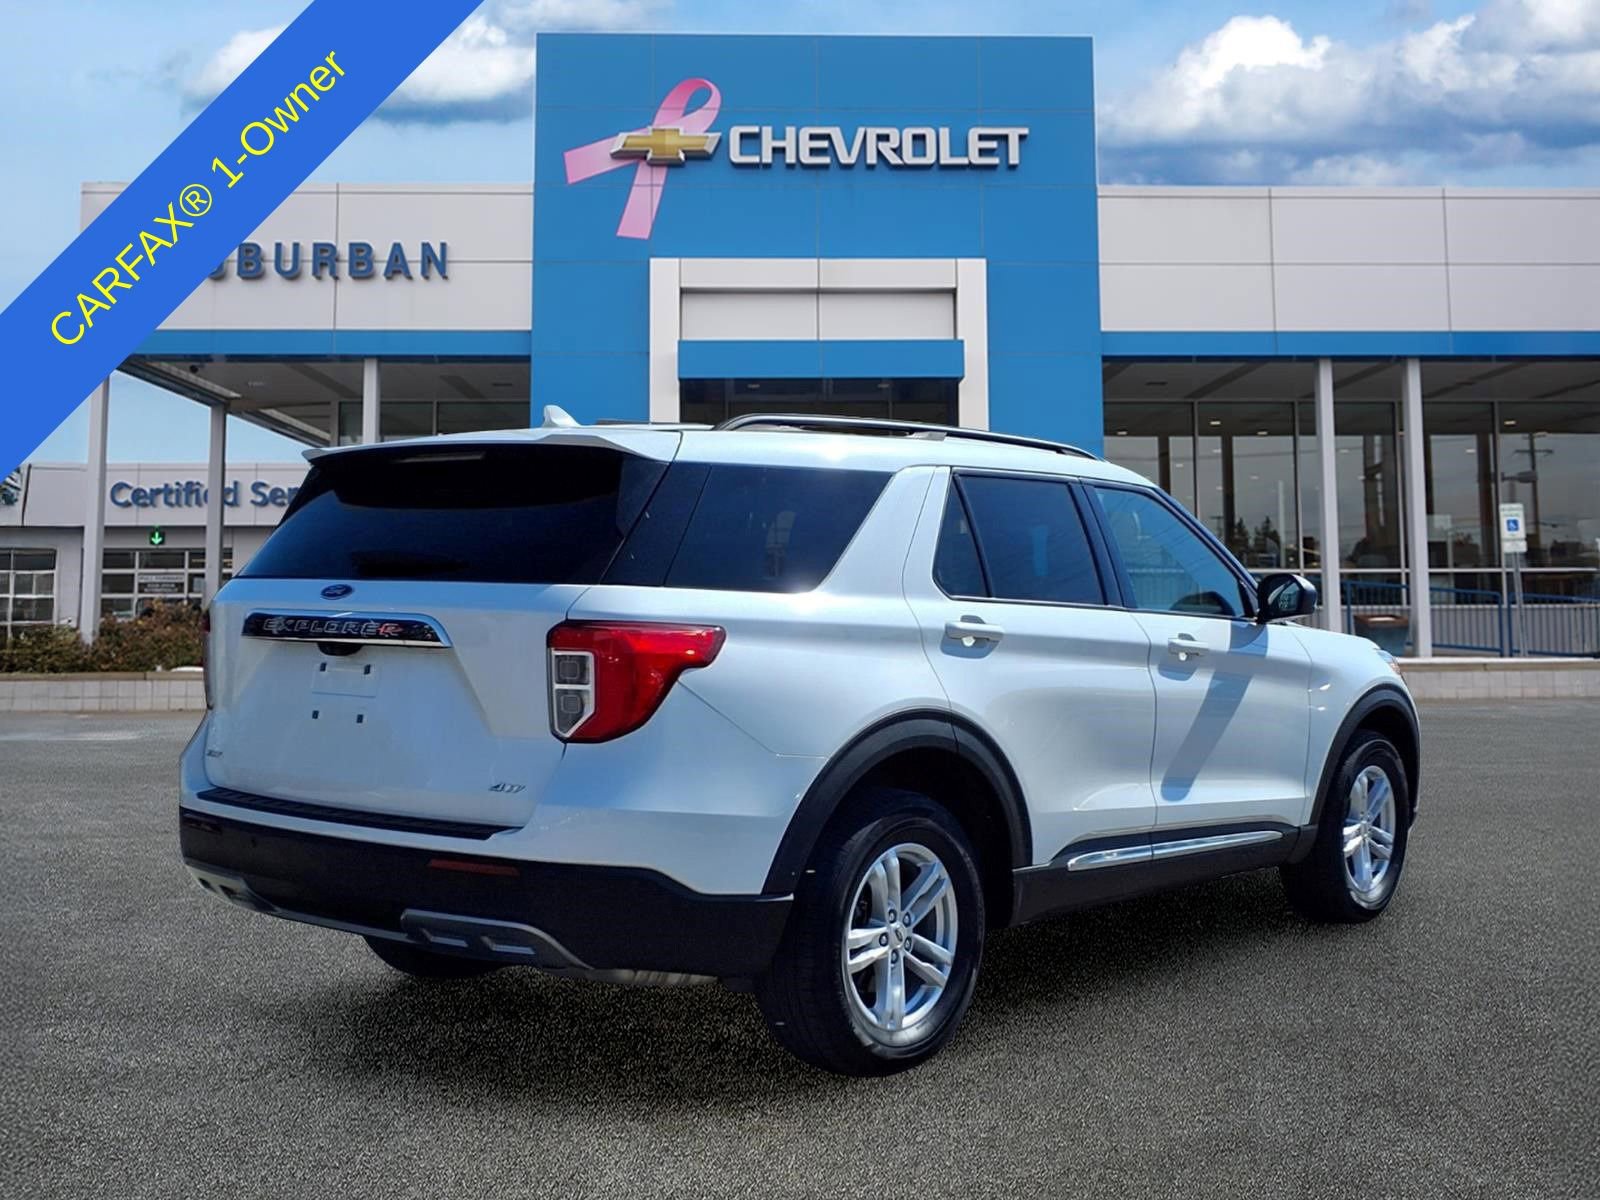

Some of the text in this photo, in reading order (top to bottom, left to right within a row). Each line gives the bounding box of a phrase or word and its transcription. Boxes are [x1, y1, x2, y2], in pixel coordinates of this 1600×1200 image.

[729, 125, 1029, 168] CHEVROLET
[208, 241, 449, 280] BURBAN
[263, 616, 402, 637] EXPLORER
